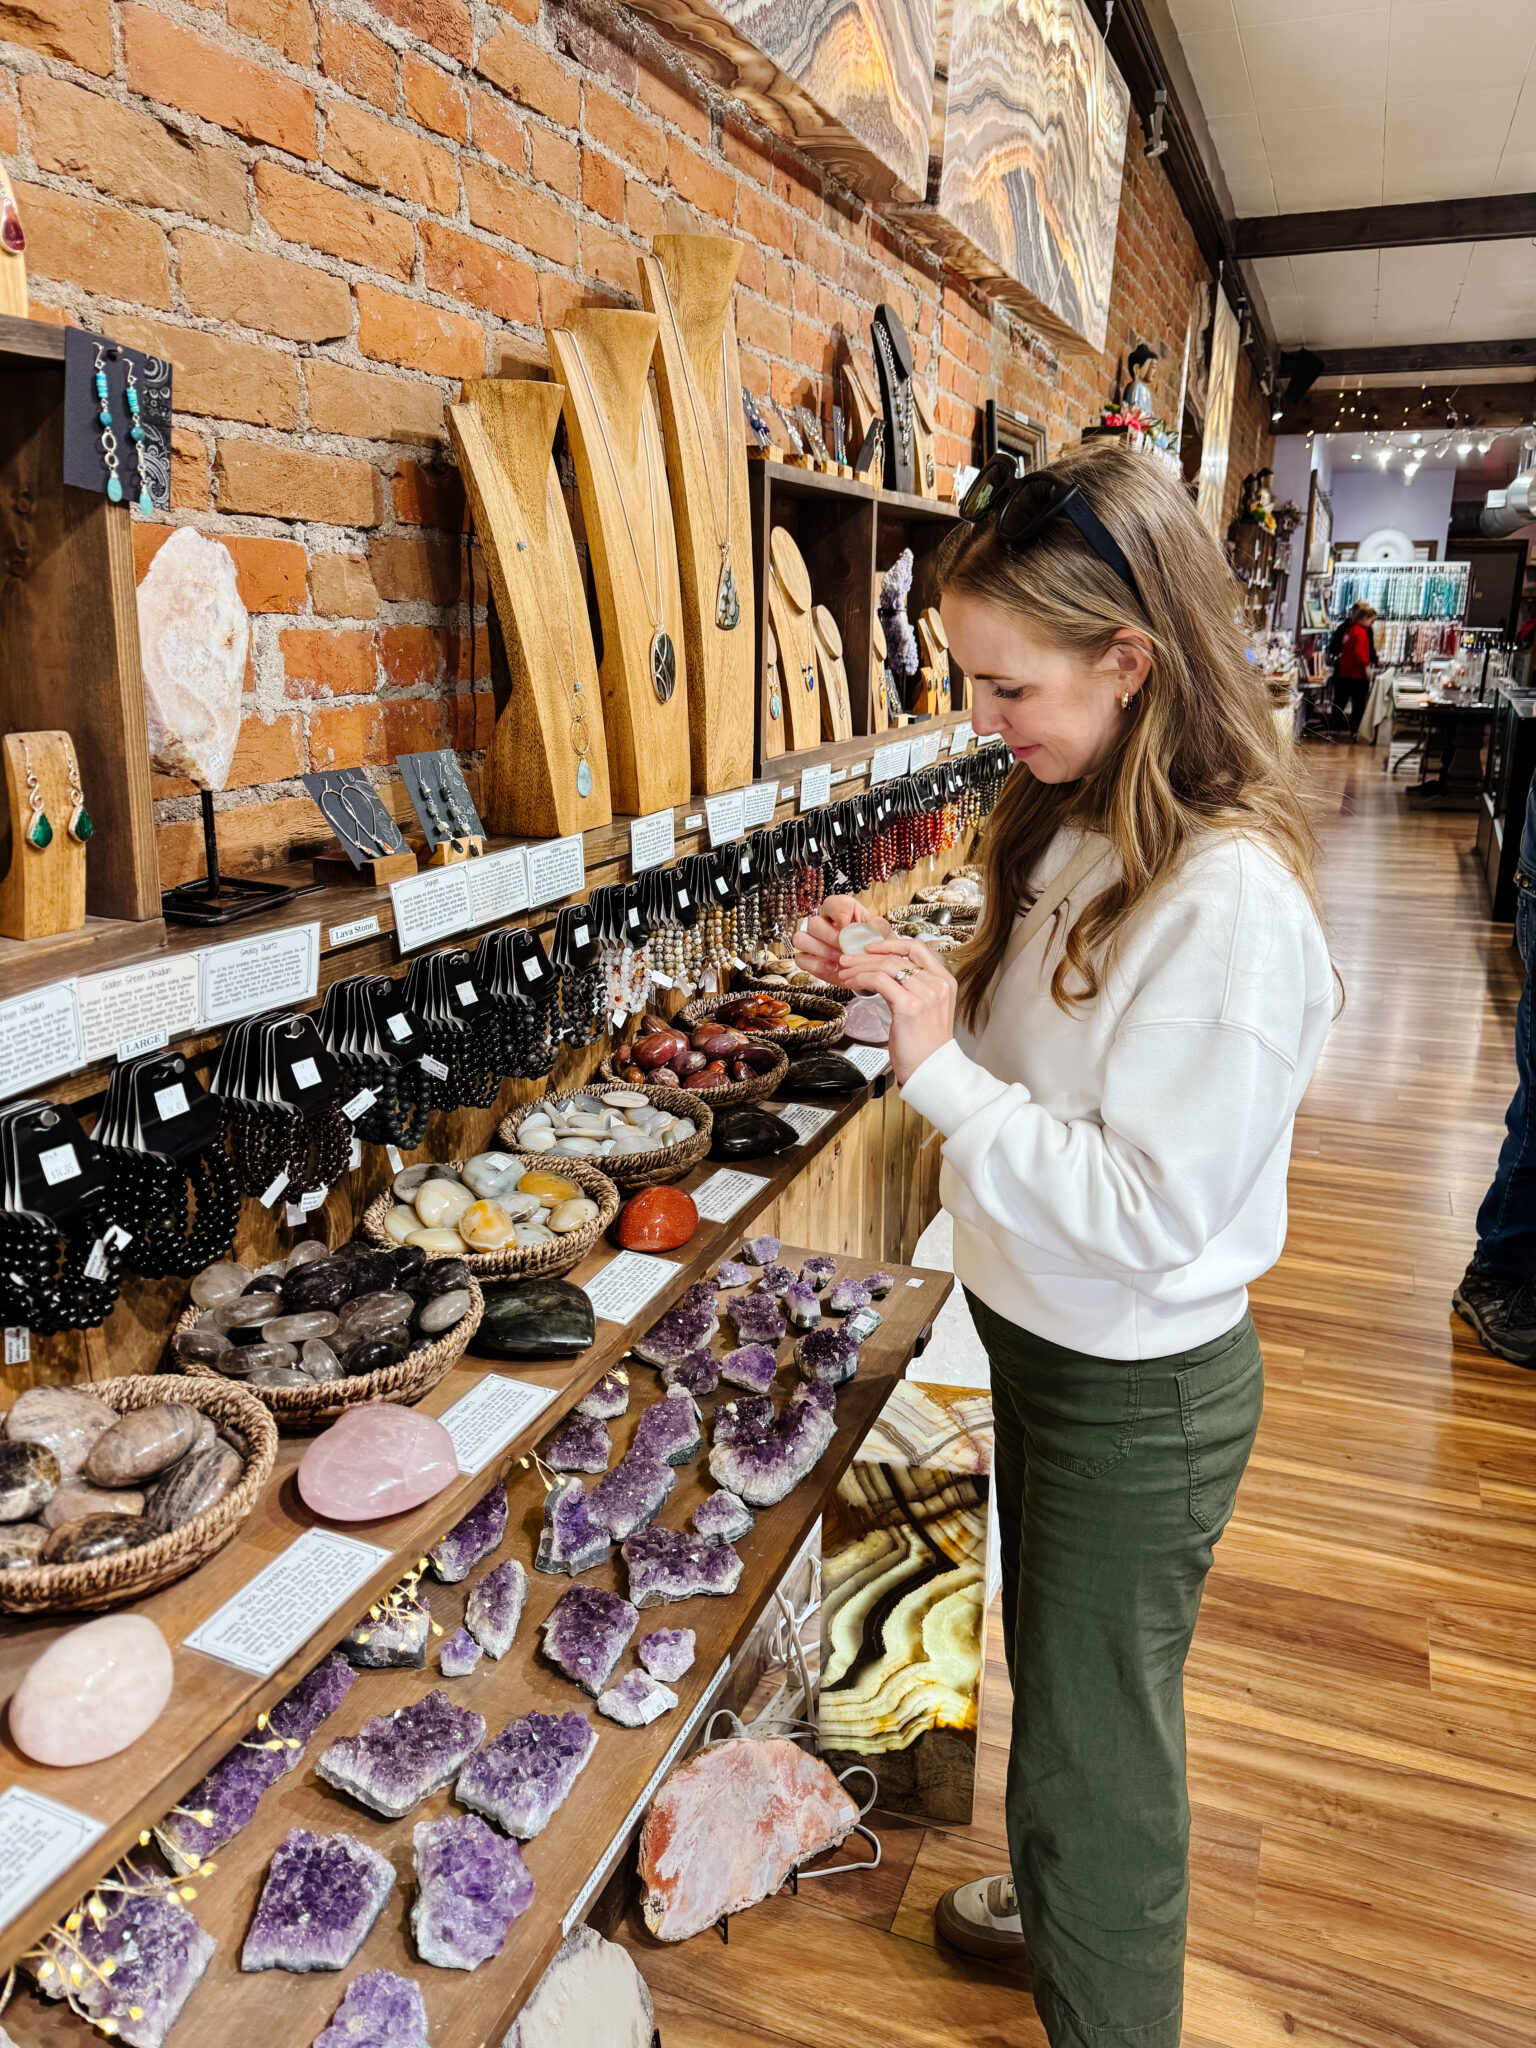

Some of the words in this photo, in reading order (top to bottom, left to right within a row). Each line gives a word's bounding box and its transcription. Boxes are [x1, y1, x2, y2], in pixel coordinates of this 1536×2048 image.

[335, 929, 354, 940] Lava
[354, 922, 374, 934] Stone
[261, 941, 278, 952] Quartz
[148, 967, 172, 978] Obsidian
[127, 1034, 161, 1053] LARGE
